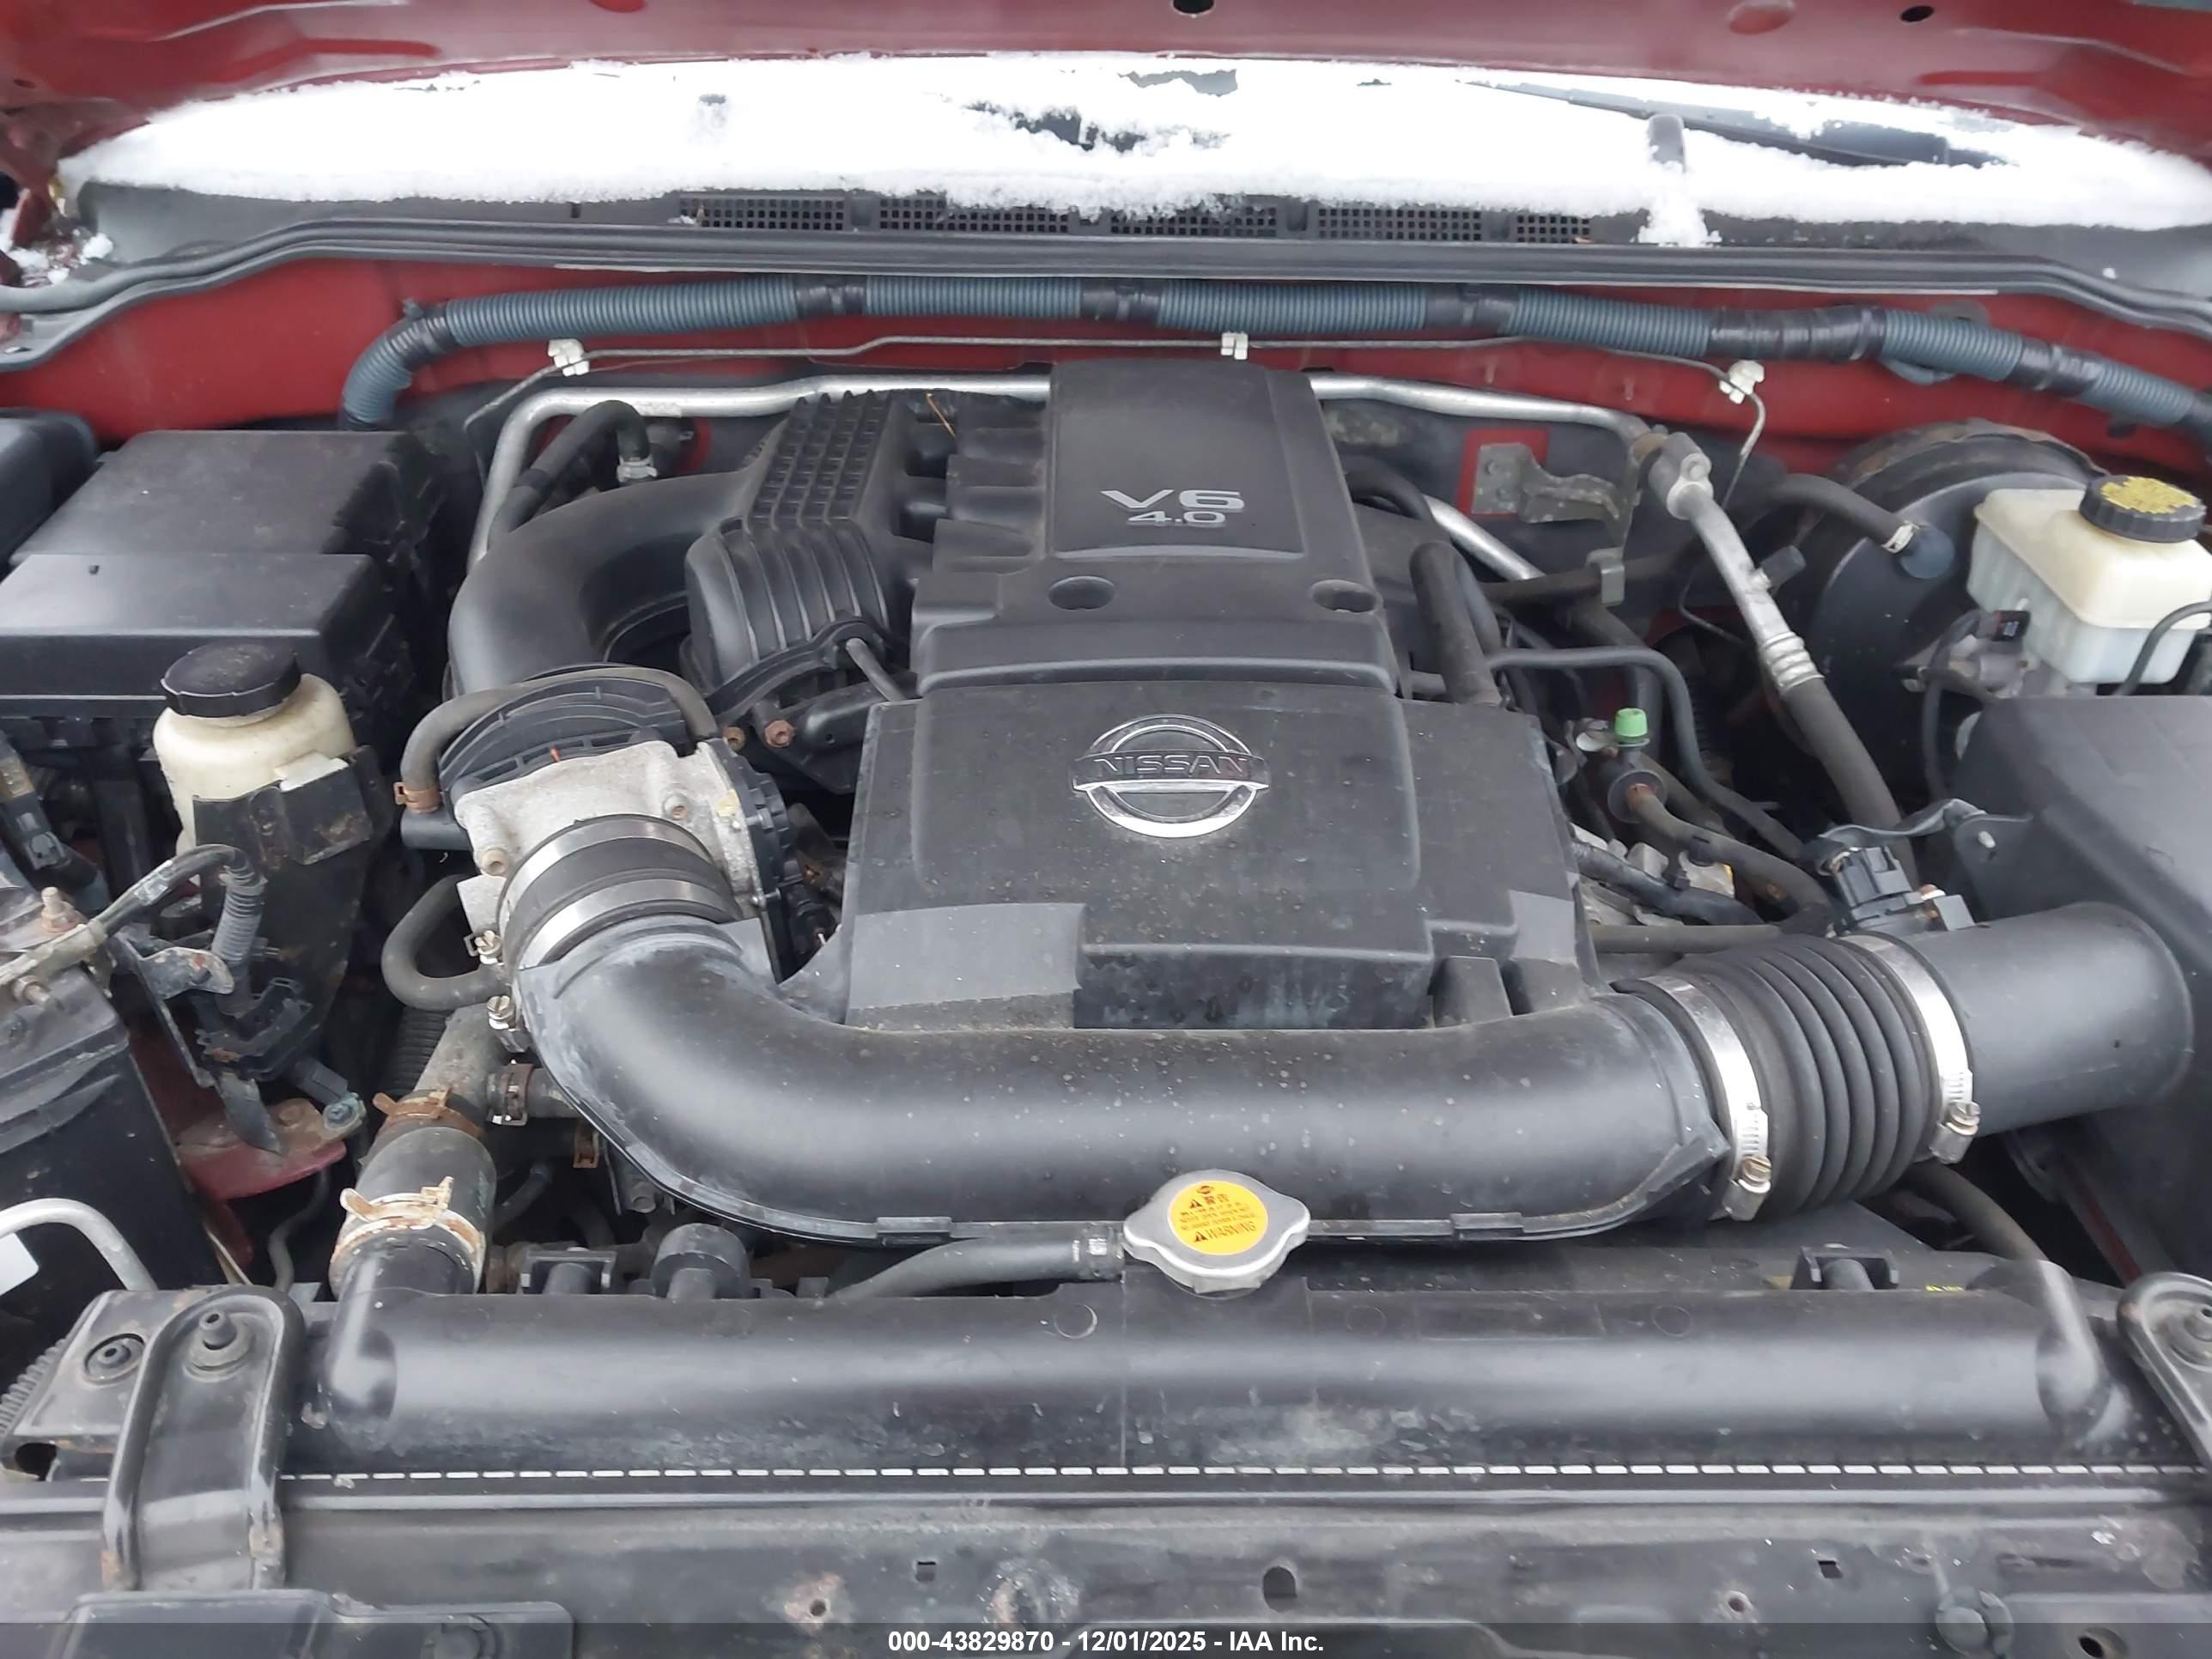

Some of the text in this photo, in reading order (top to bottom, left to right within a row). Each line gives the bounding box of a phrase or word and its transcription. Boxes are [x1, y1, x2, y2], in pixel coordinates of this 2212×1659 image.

[1099, 489, 1245, 510] V6
[1127, 510, 1226, 525] 4.0
[1092, 755, 1249, 775] NISSAN
